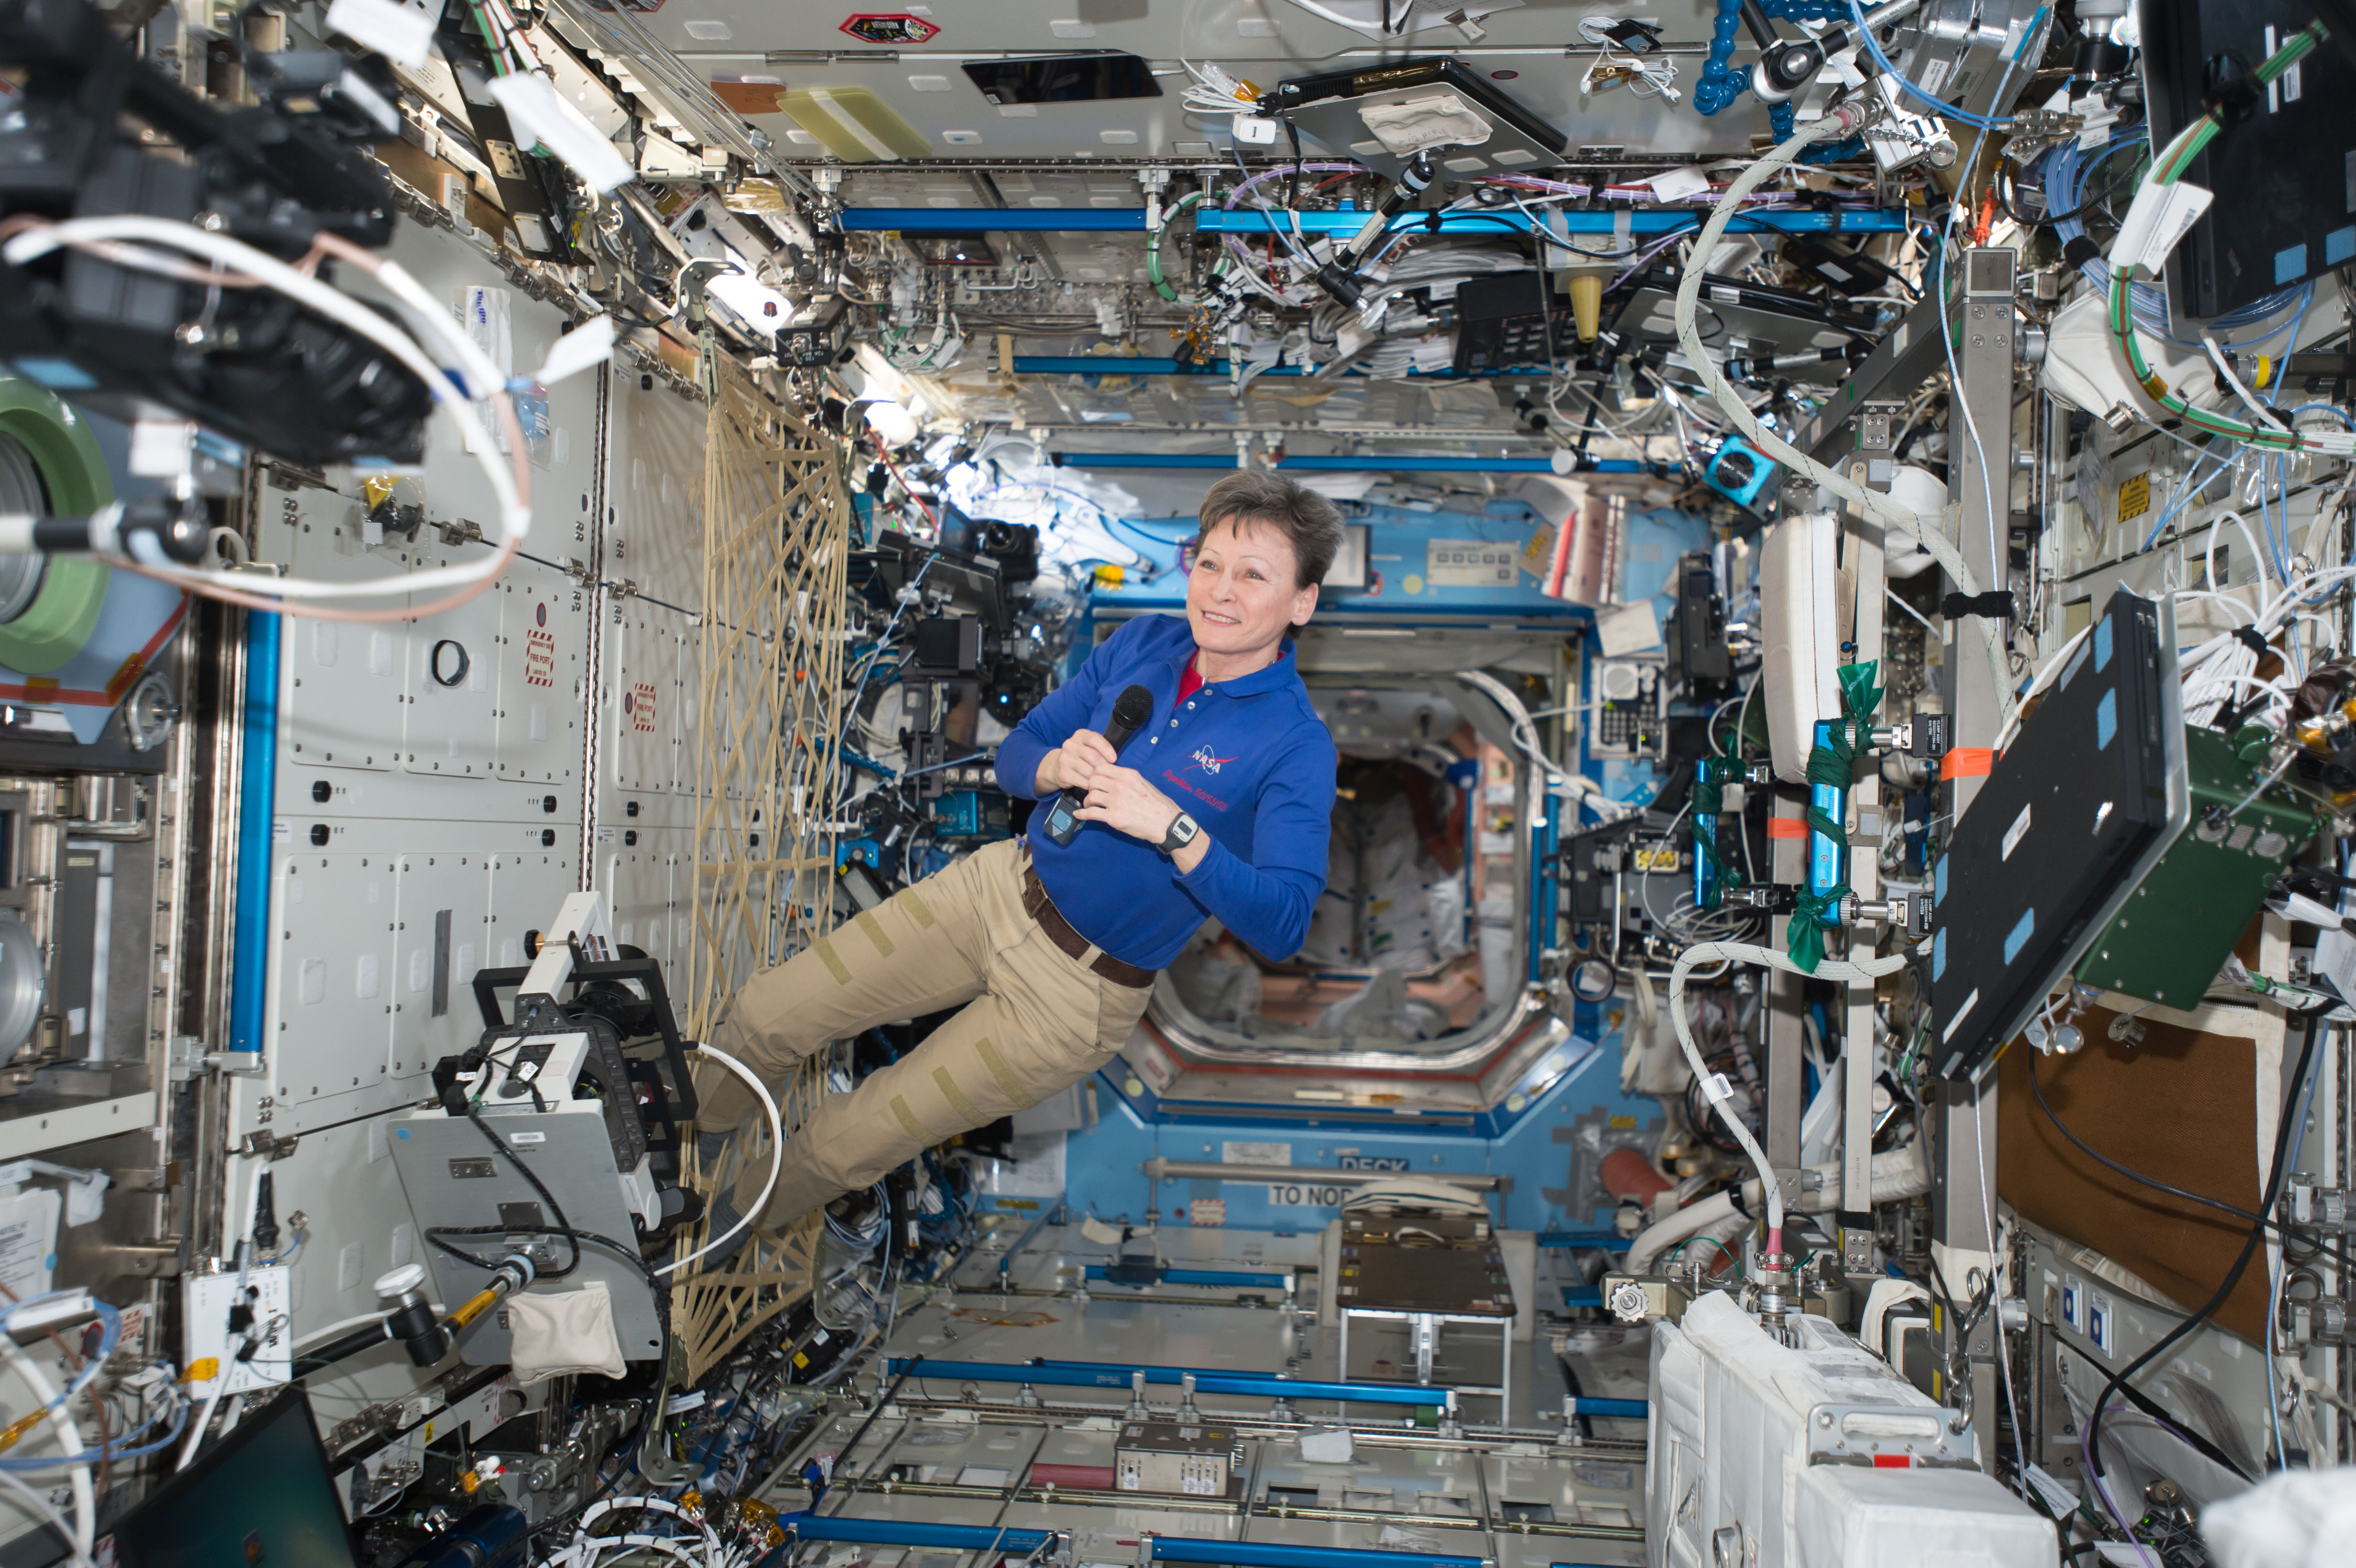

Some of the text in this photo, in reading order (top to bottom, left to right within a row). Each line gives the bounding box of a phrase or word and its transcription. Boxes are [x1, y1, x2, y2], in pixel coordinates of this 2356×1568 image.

[530, 640, 545, 648] EMERGENCY
[530, 653, 550, 665] FIRE PORT
[644, 705, 653, 713] PORT
[1192, 749, 1221, 774] NASA
[1194, 787, 1228, 811] 50/51/52
[1341, 1158, 1406, 1171] DECK
[1273, 1186, 1301, 1205] TO
